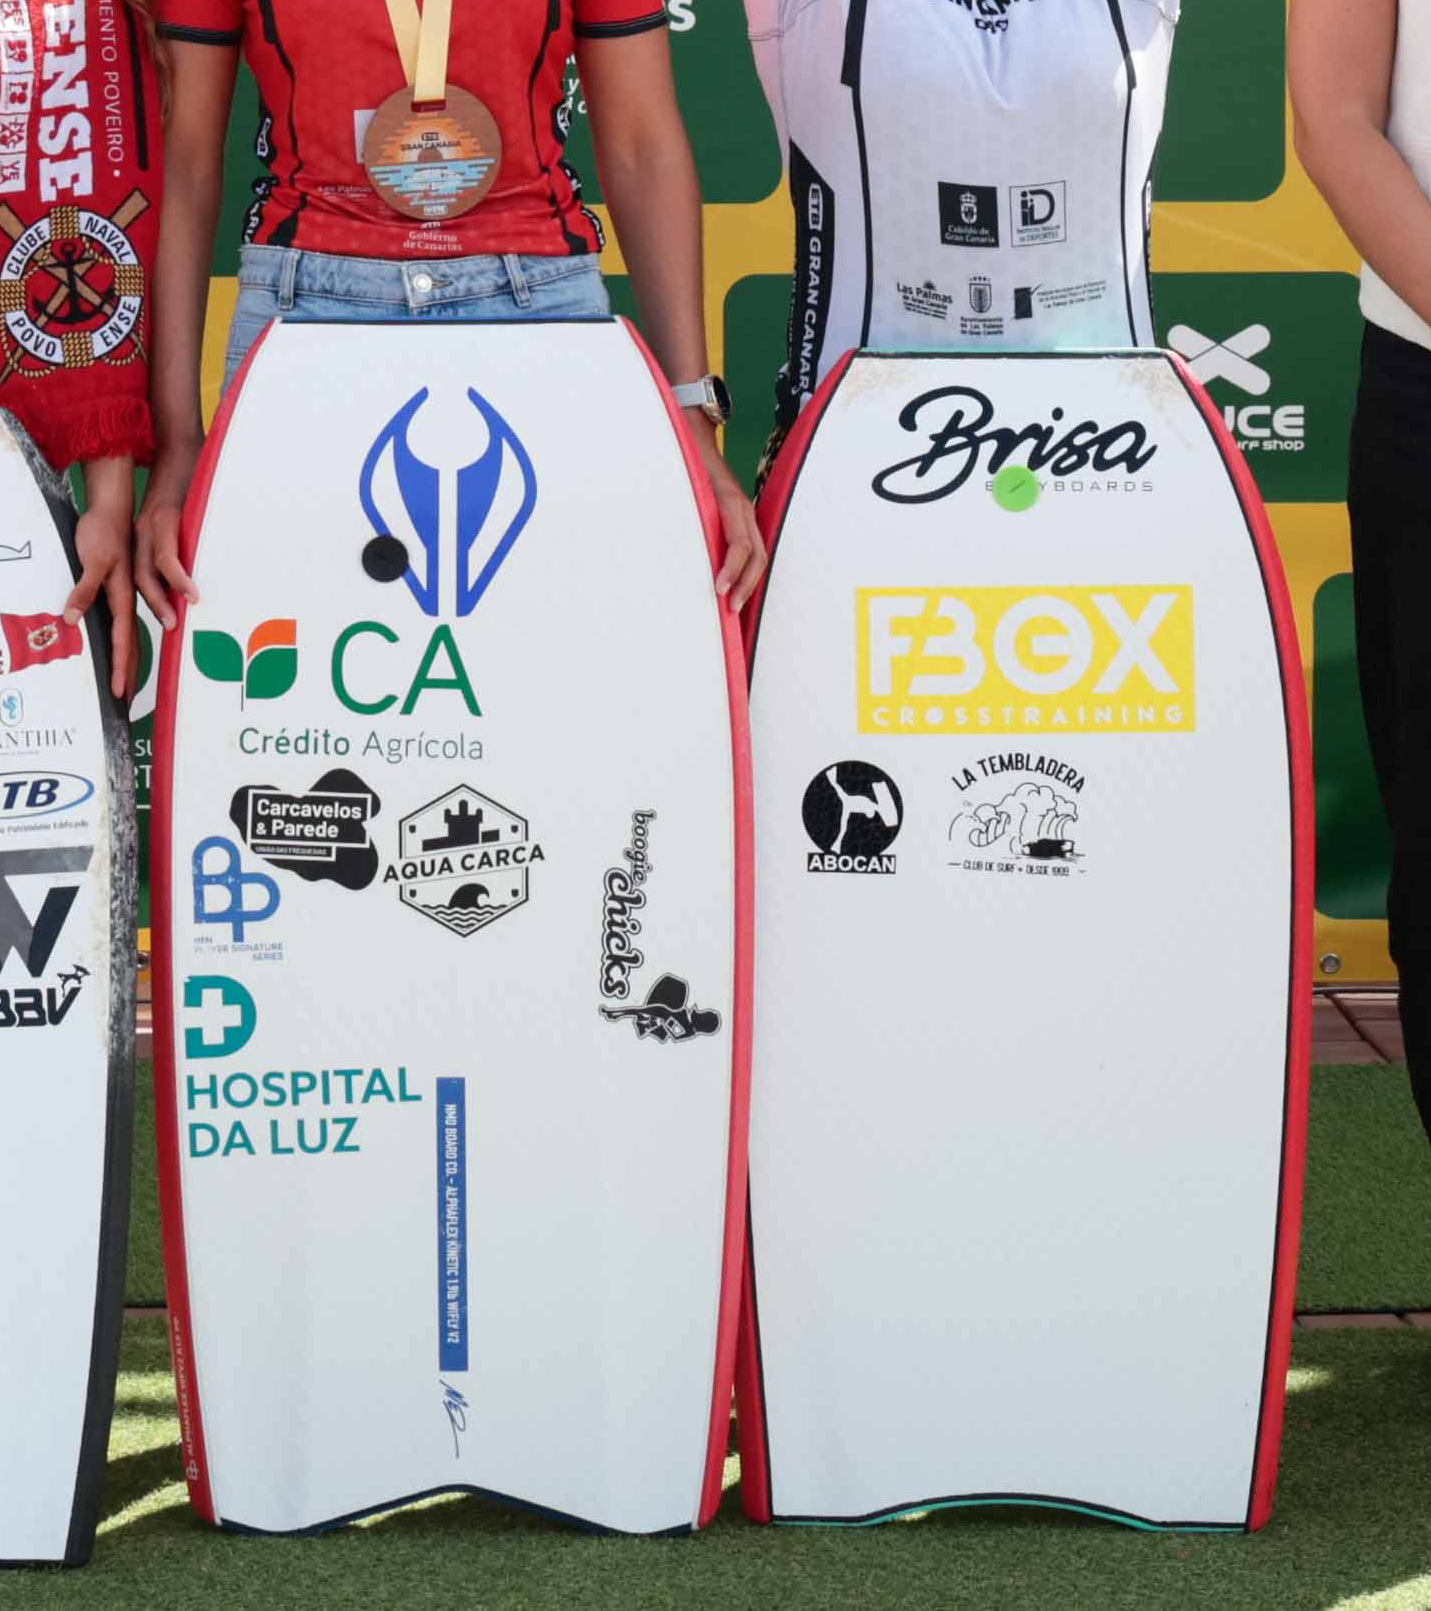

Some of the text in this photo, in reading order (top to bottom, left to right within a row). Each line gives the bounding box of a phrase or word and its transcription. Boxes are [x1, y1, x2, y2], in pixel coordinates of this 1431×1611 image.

[104, 72, 124, 162] POVEIRO
[7, 216, 129, 275] CLUBE NAVAL
[11, 301, 137, 357] POVO ENSE
[871, 386, 1157, 504] Brisa
[331, 620, 483, 717] CA
[872, 706, 1184, 726] CROSSTRAINING
[239, 727, 484, 764] Crédito Agrícola
[952, 753, 1086, 793] LA TEMBLADERA
[257, 798, 363, 820] Carcavelos
[256, 820, 338, 839] & Parede
[383, 844, 546, 884] AQUA CARCA
[809, 855, 895, 872] ABOCAN
[186, 1067, 422, 1110] HOSPITAL
[189, 1117, 360, 1158] DA LUZ
